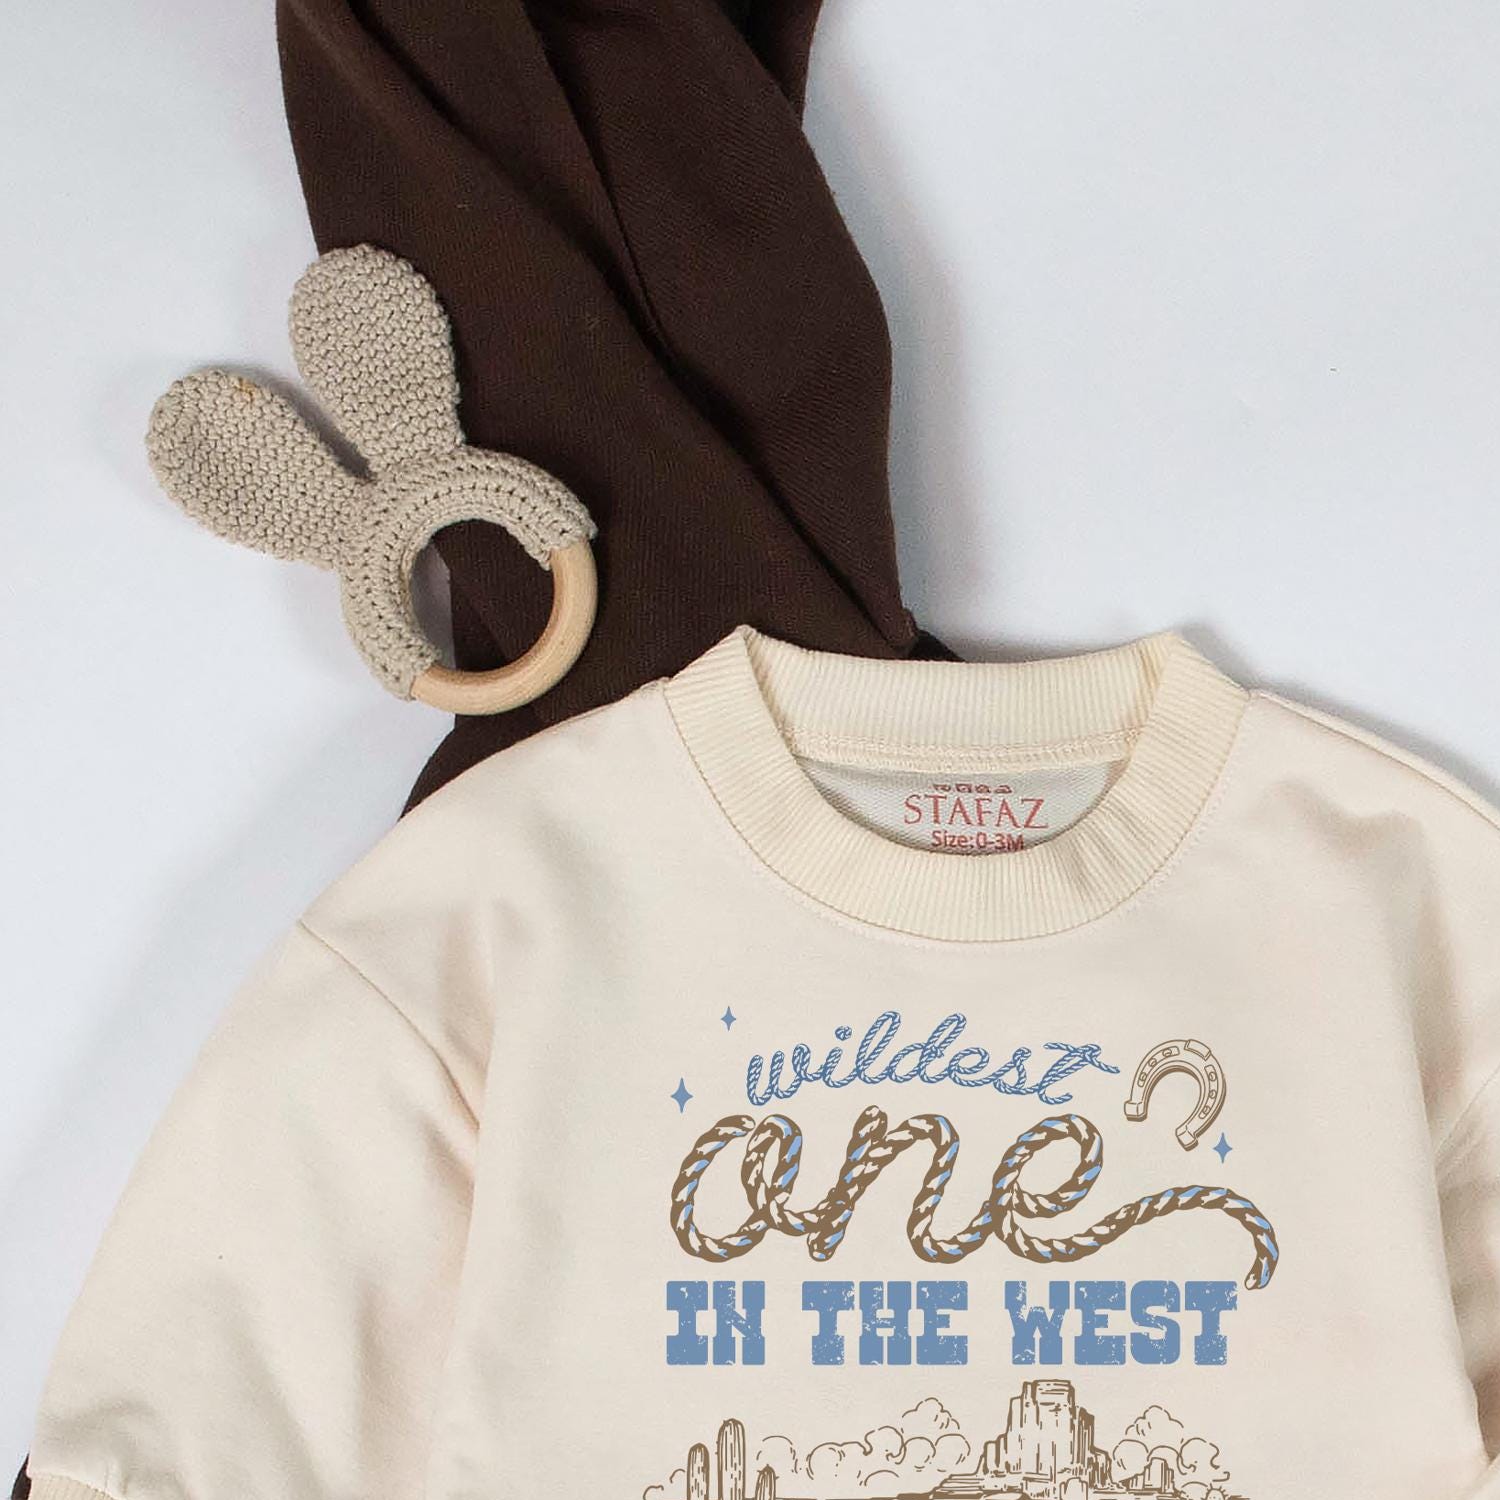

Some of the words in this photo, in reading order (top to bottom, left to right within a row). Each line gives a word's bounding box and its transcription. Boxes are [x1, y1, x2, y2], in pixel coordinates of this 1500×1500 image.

[903, 794, 1049, 829] STAFAZ
[746, 1010, 1120, 1106] wildest
[666, 1281, 766, 1366] IN
[802, 1281, 969, 1366] THE
[1004, 1281, 1238, 1366] WEST
